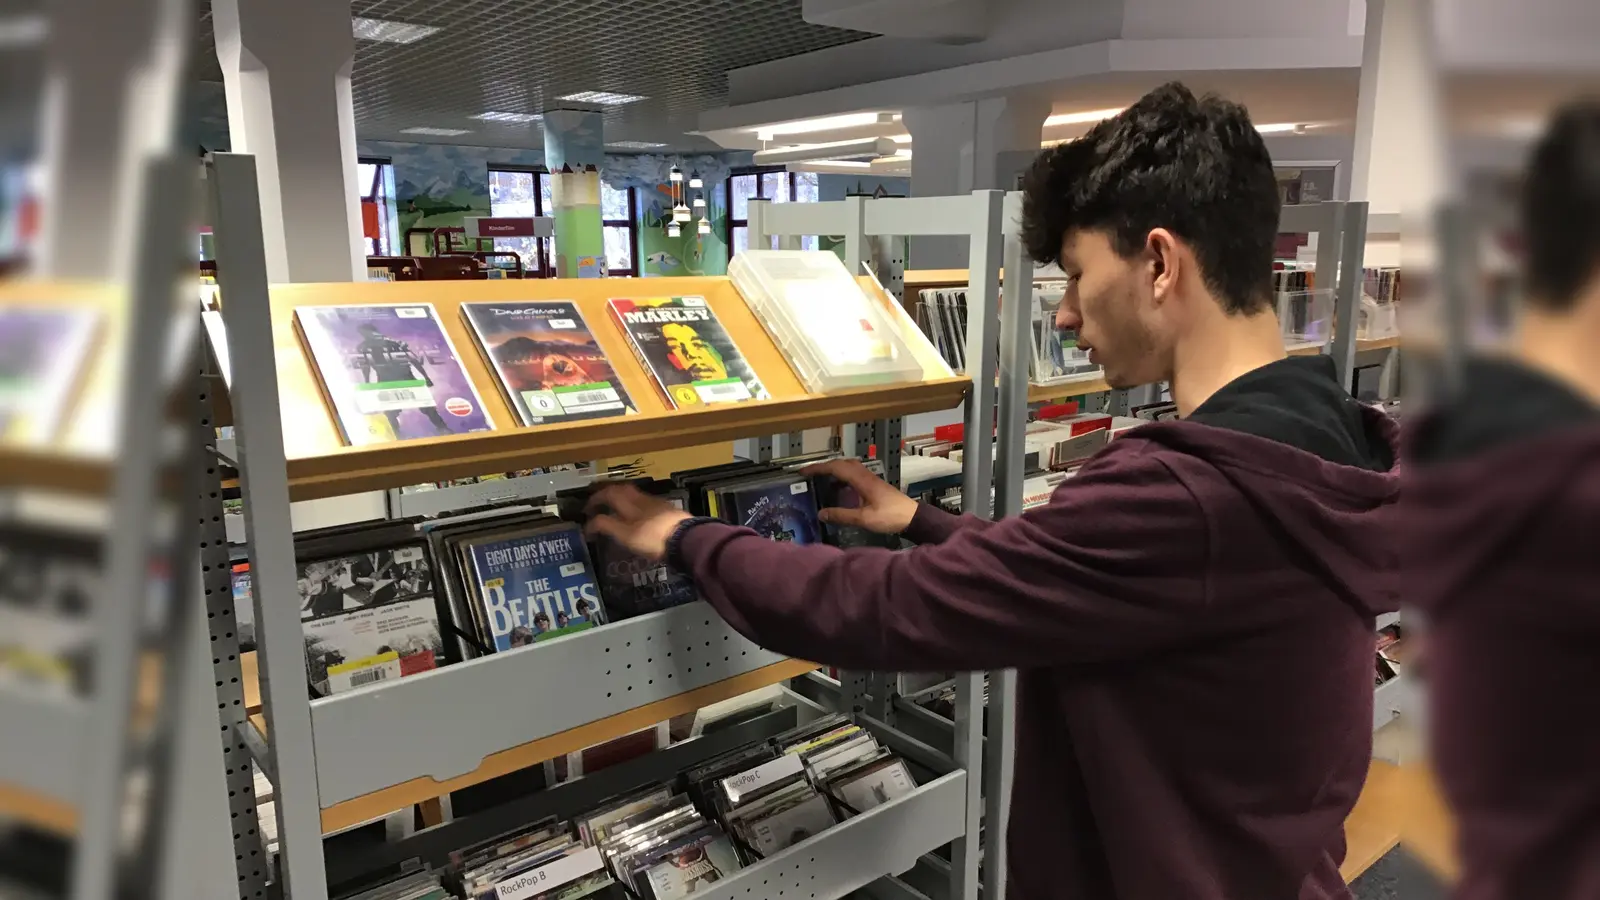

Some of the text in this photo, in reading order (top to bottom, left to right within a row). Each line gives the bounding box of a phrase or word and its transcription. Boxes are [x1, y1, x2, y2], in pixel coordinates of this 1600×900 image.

[623, 309, 710, 323] MARLEY
[485, 548, 513, 567] EIGHT
[513, 544, 539, 561] DAYS
[539, 542, 547, 557] A
[544, 538, 573, 555] WEEK
[525, 578, 551, 594] THE
[483, 583, 600, 637] BEATLES
[728, 774, 756, 789] RockPop
[754, 770, 761, 779] C
[500, 870, 547, 896] RockPop B
